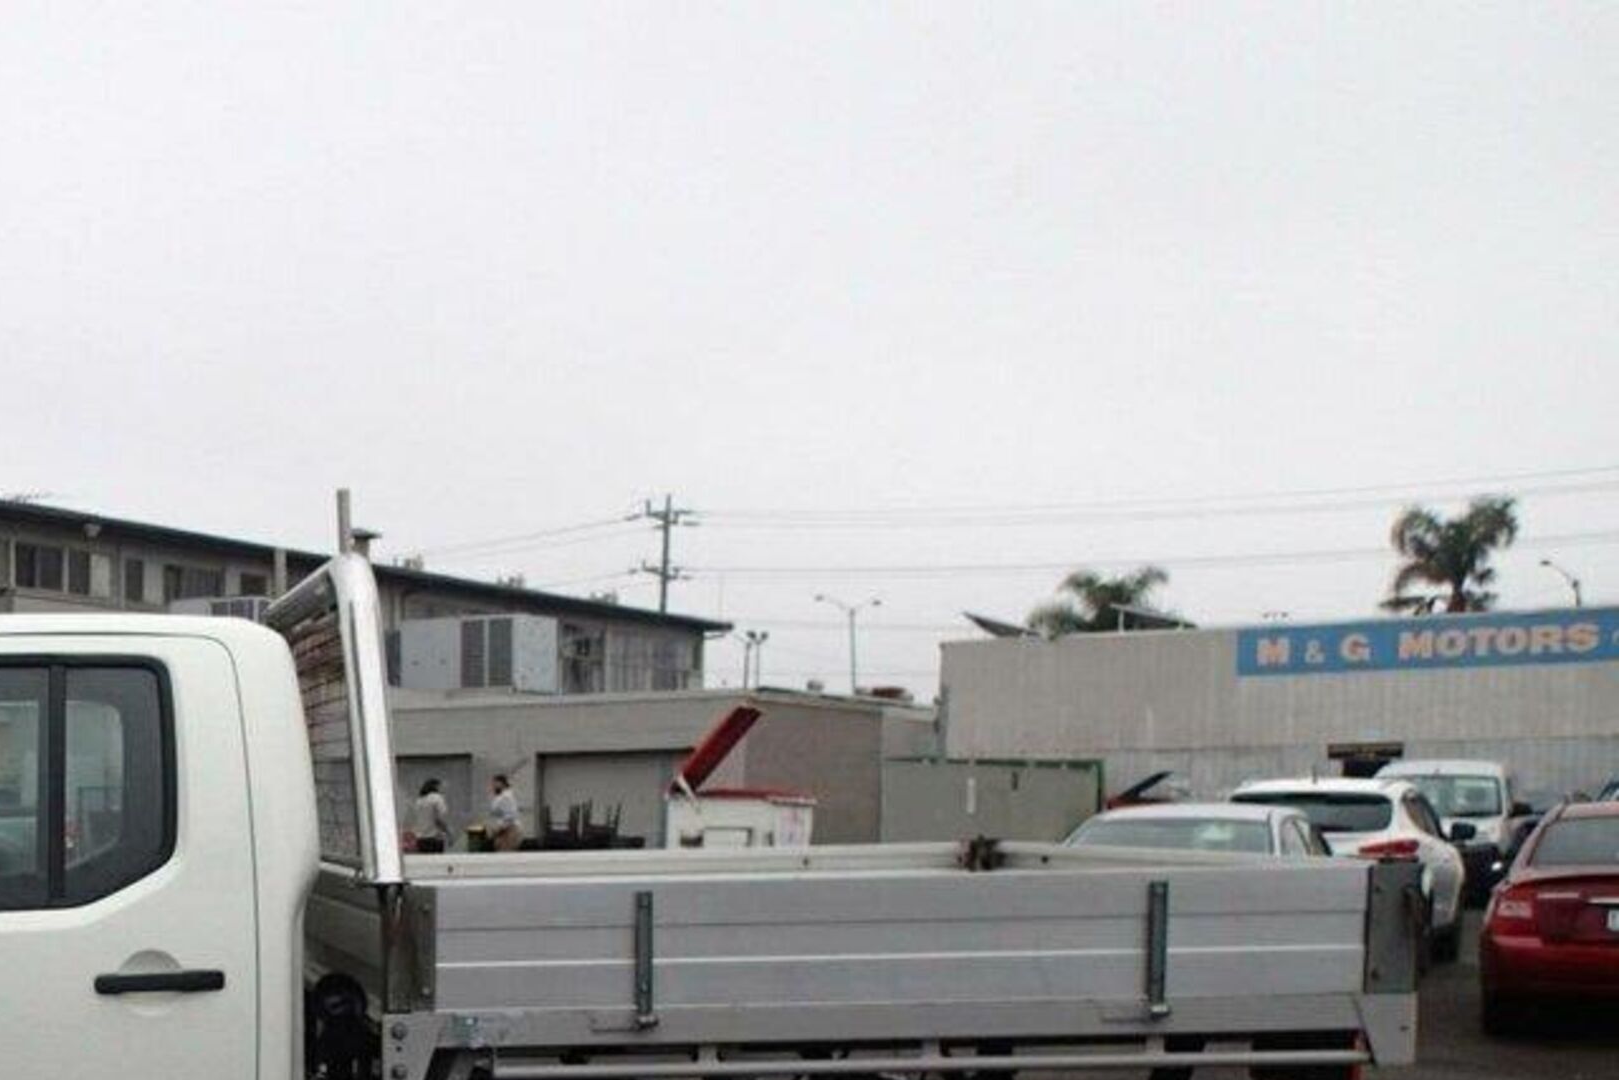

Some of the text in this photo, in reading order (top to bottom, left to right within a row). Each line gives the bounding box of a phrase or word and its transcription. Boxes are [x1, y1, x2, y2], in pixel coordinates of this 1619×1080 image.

[1257, 638, 1290, 666] M
[1304, 639, 1325, 664] &
[1340, 634, 1371, 662] G
[1399, 623, 1600, 660] MOTORS
